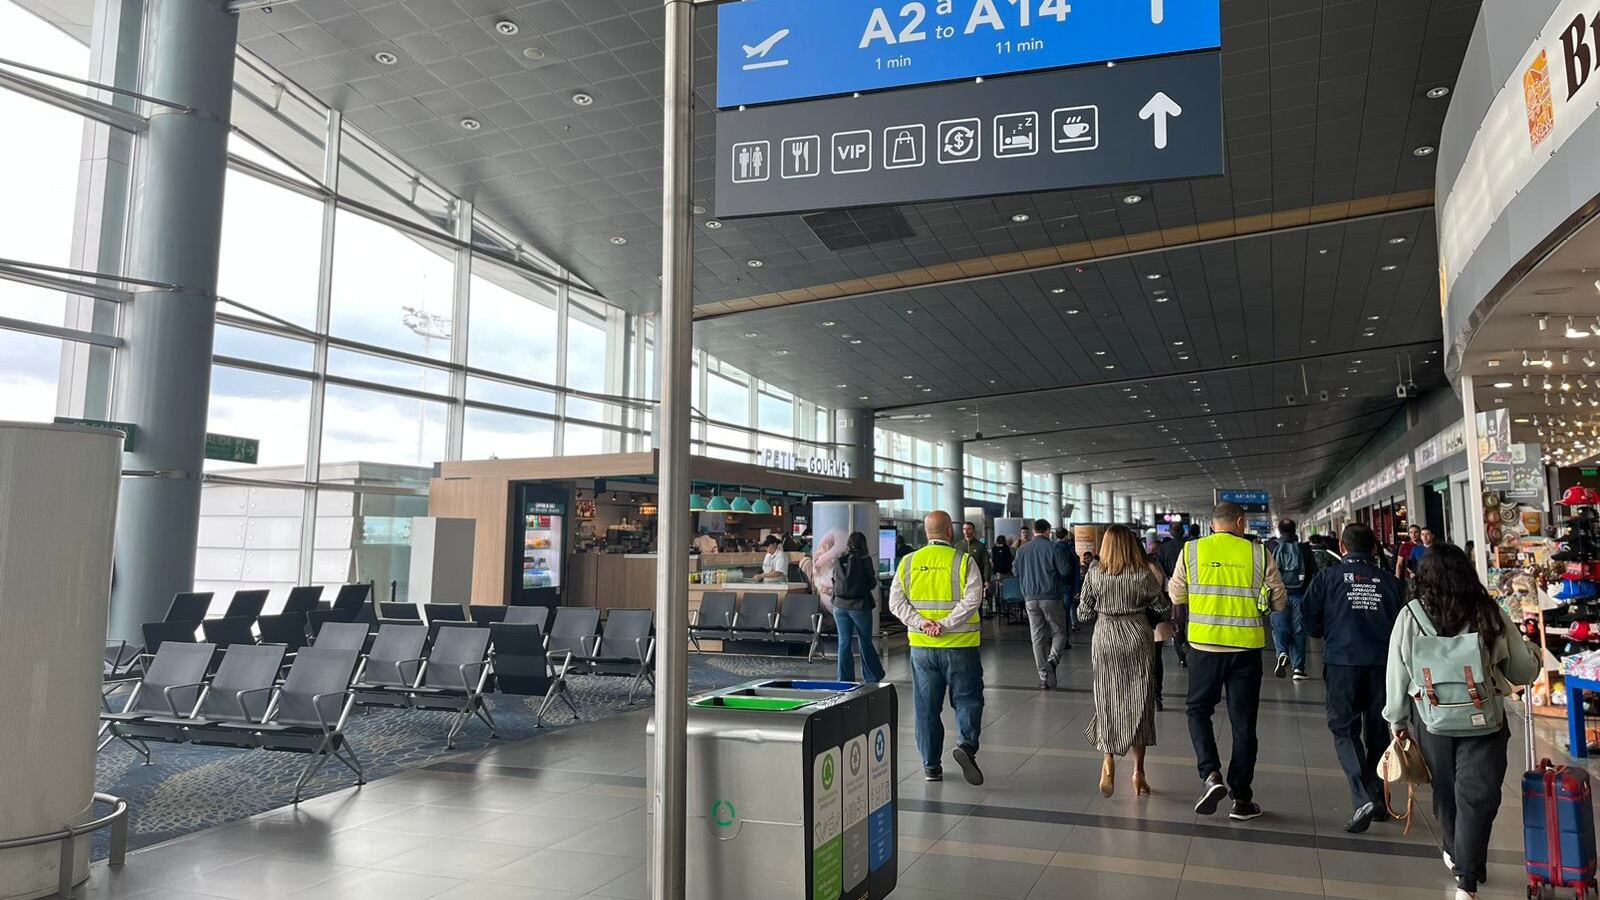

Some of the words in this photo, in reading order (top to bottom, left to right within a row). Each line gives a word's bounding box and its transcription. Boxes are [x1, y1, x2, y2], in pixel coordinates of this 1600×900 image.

[859, 2, 926, 48] A2
[964, 0, 1072, 34] A14
[935, 25, 954, 39] to
[995, 42, 1011, 55] 11
[1017, 38, 1044, 53] min
[875, 58, 882, 70] 1
[887, 55, 911, 69] min
[837, 143, 867, 160] VIP
[763, 448, 798, 470] PETIT
[808, 456, 852, 478] GOURMET
